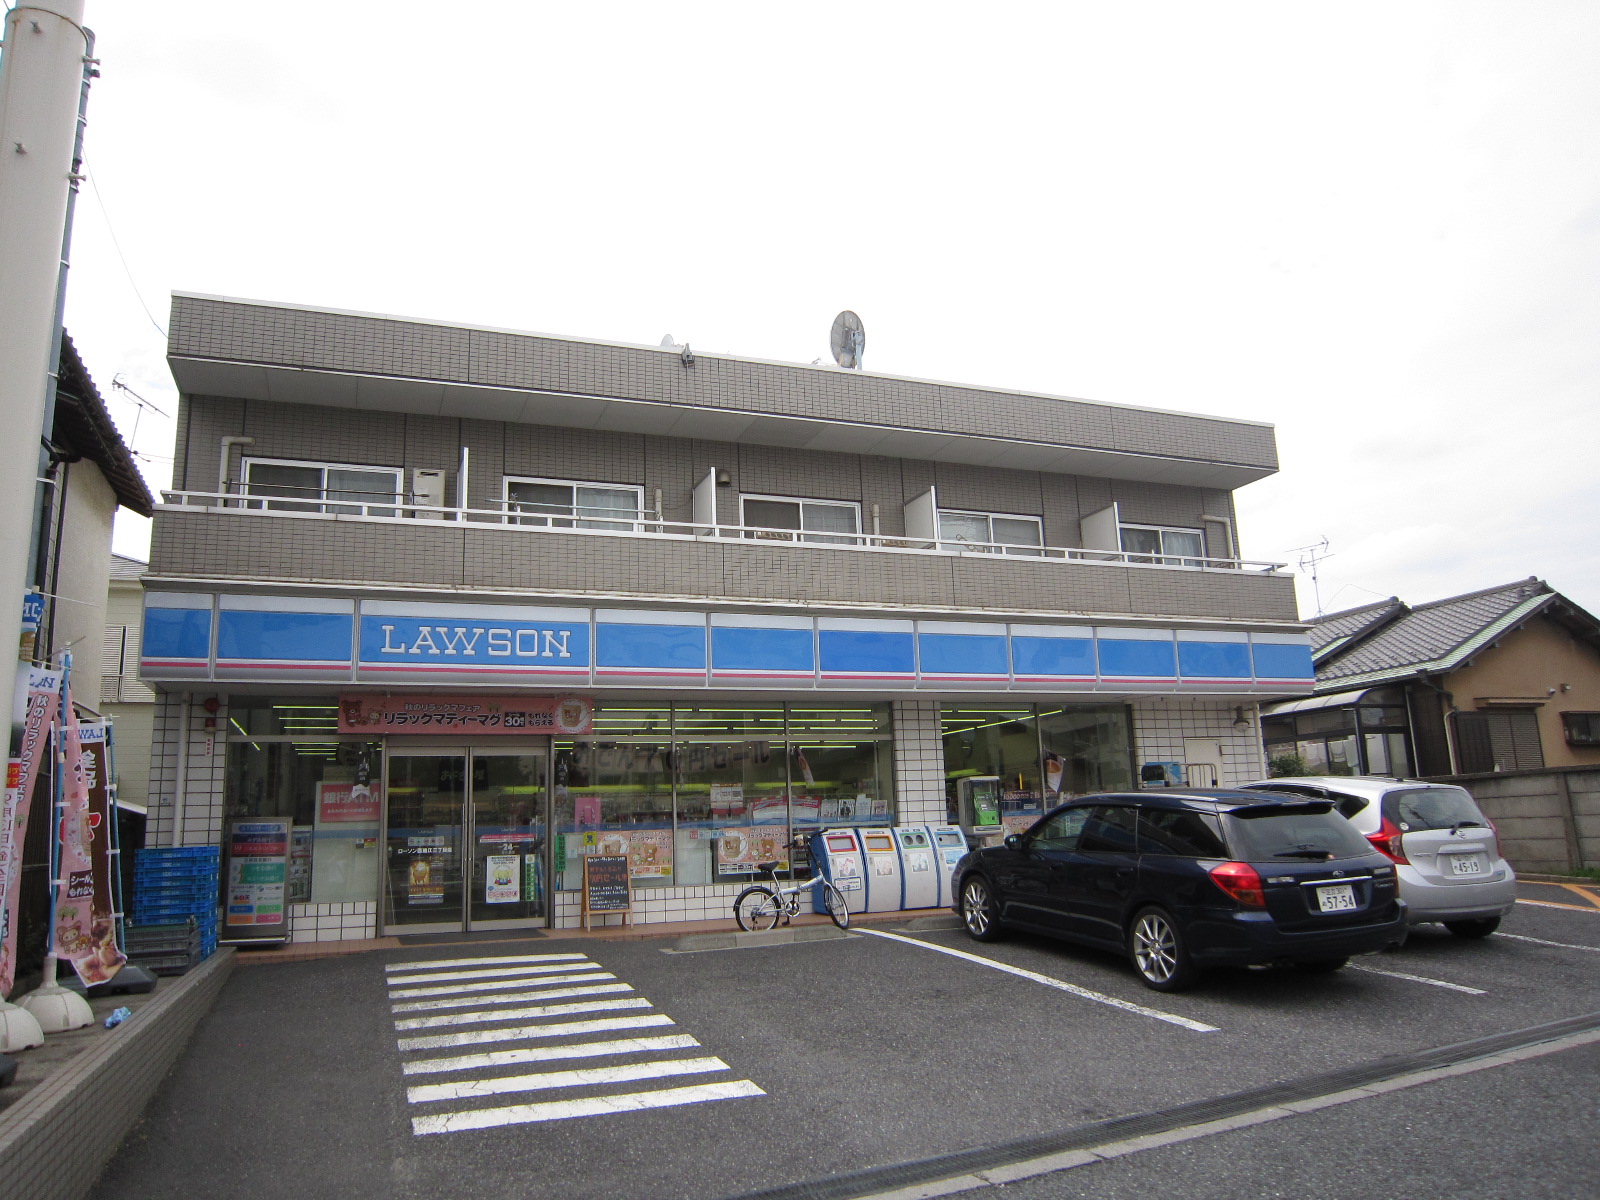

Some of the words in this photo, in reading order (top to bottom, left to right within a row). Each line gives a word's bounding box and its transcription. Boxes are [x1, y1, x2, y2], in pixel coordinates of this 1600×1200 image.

[380, 625, 572, 658] LAWSON
[405, 703, 481, 713] 秋のリラックマフェア
[384, 711, 502, 728] リラックマティーマグ
[1459, 861, 1479, 873] 45-19
[1327, 894, 1355, 909] 57-54
